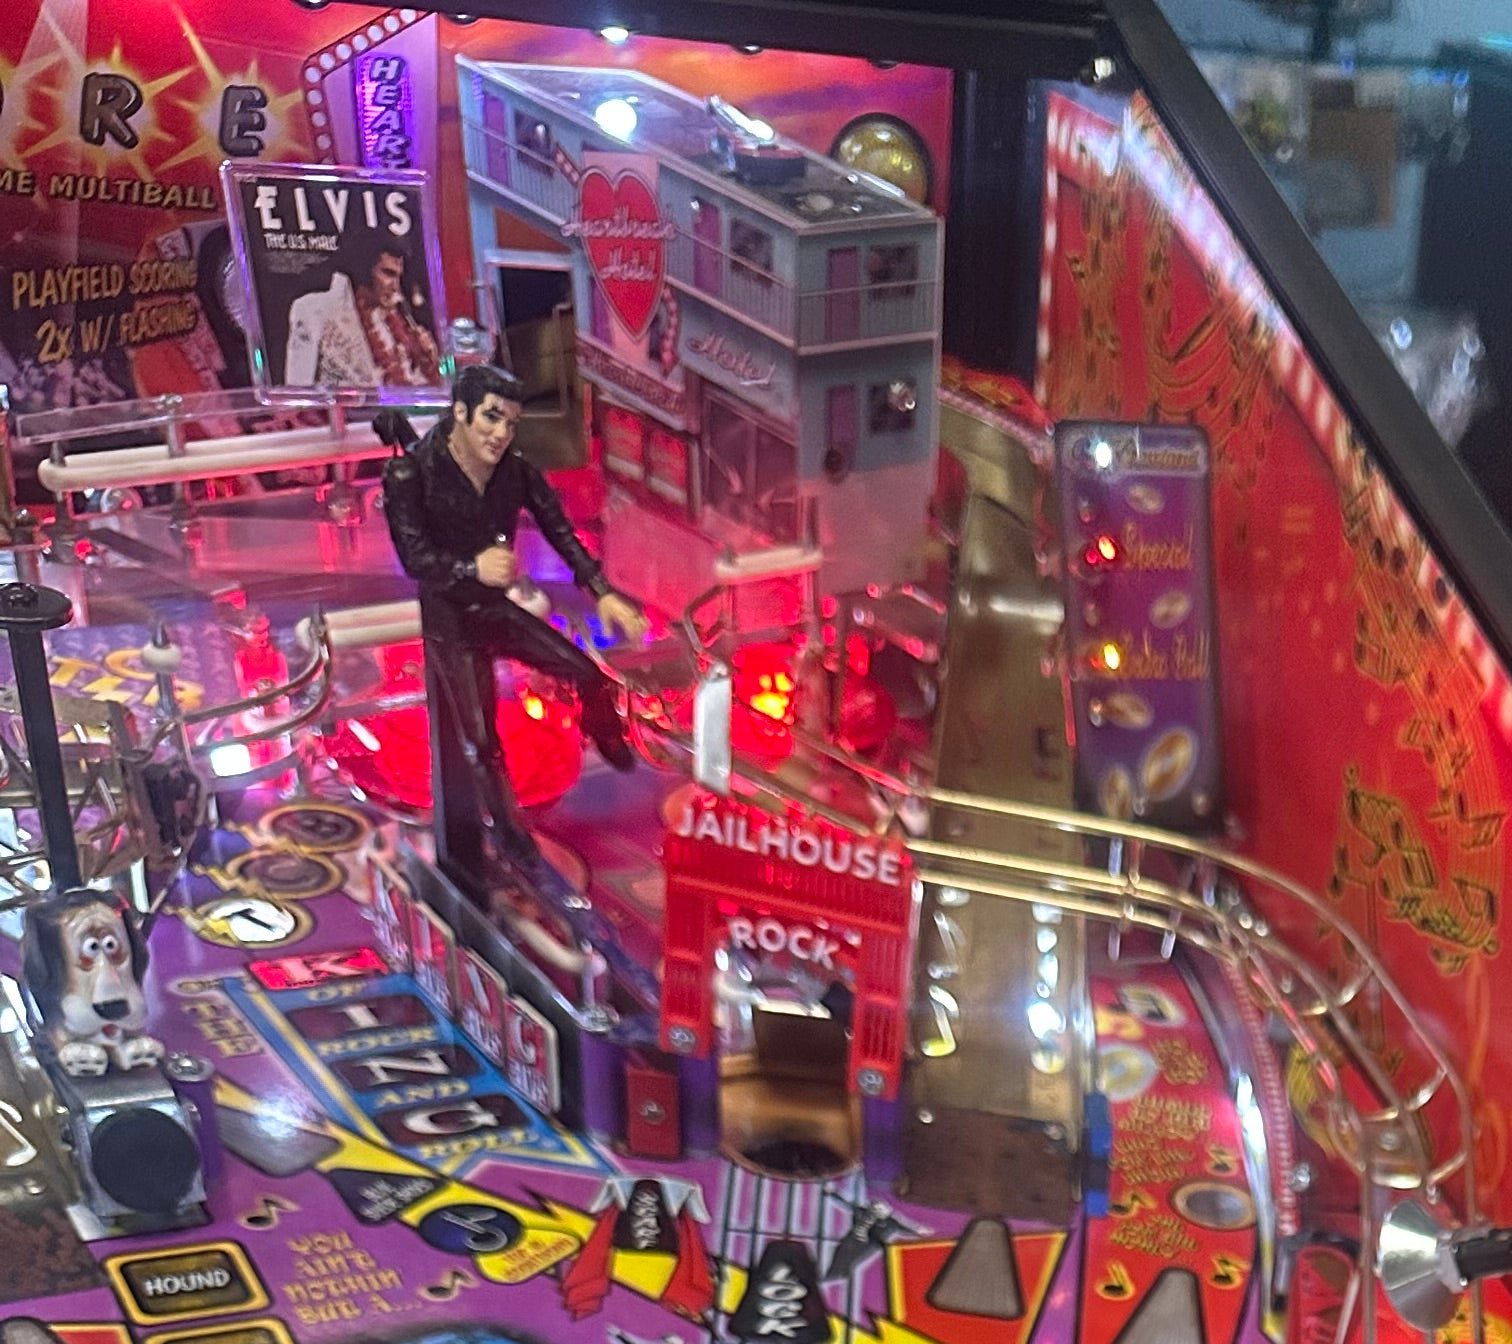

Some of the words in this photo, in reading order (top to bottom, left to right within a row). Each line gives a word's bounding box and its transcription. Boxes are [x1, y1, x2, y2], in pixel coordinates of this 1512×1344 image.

[50, 174, 217, 209] MULTIBALL
[254, 185, 412, 236] ELVIS
[12, 264, 124, 311] PLAYFIELD
[677, 805, 901, 887] JAILHOUSE
[728, 916, 840, 971] ROCK
[143, 1266, 231, 1296] HOUND
[761, 1264, 808, 1339] LOCK
